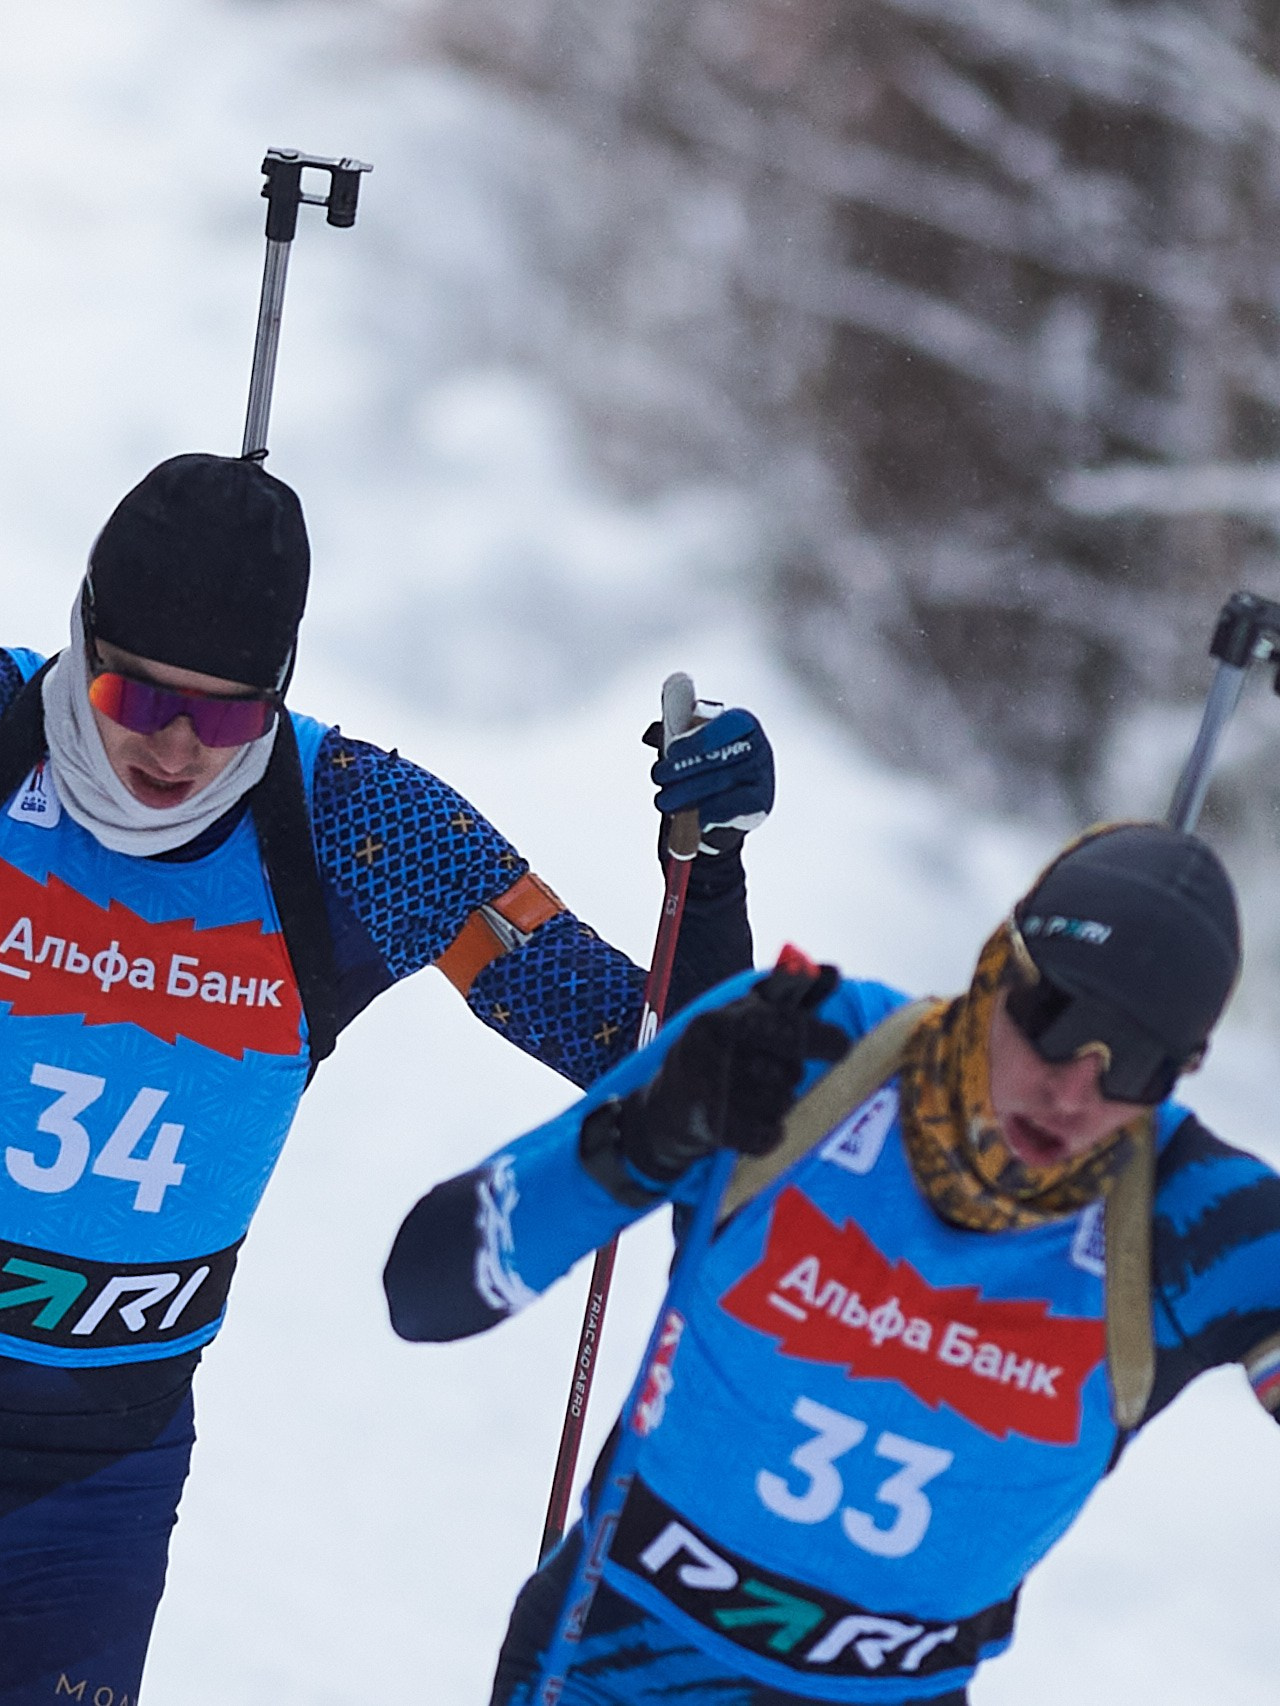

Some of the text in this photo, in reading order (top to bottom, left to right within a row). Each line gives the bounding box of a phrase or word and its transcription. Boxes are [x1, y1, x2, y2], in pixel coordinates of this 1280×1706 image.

[166, 953, 285, 1007] Банк
[5, 1062, 187, 1213] 34
[777, 1255, 1063, 1397] Альфа Банк
[756, 1397, 955, 1559] 33
